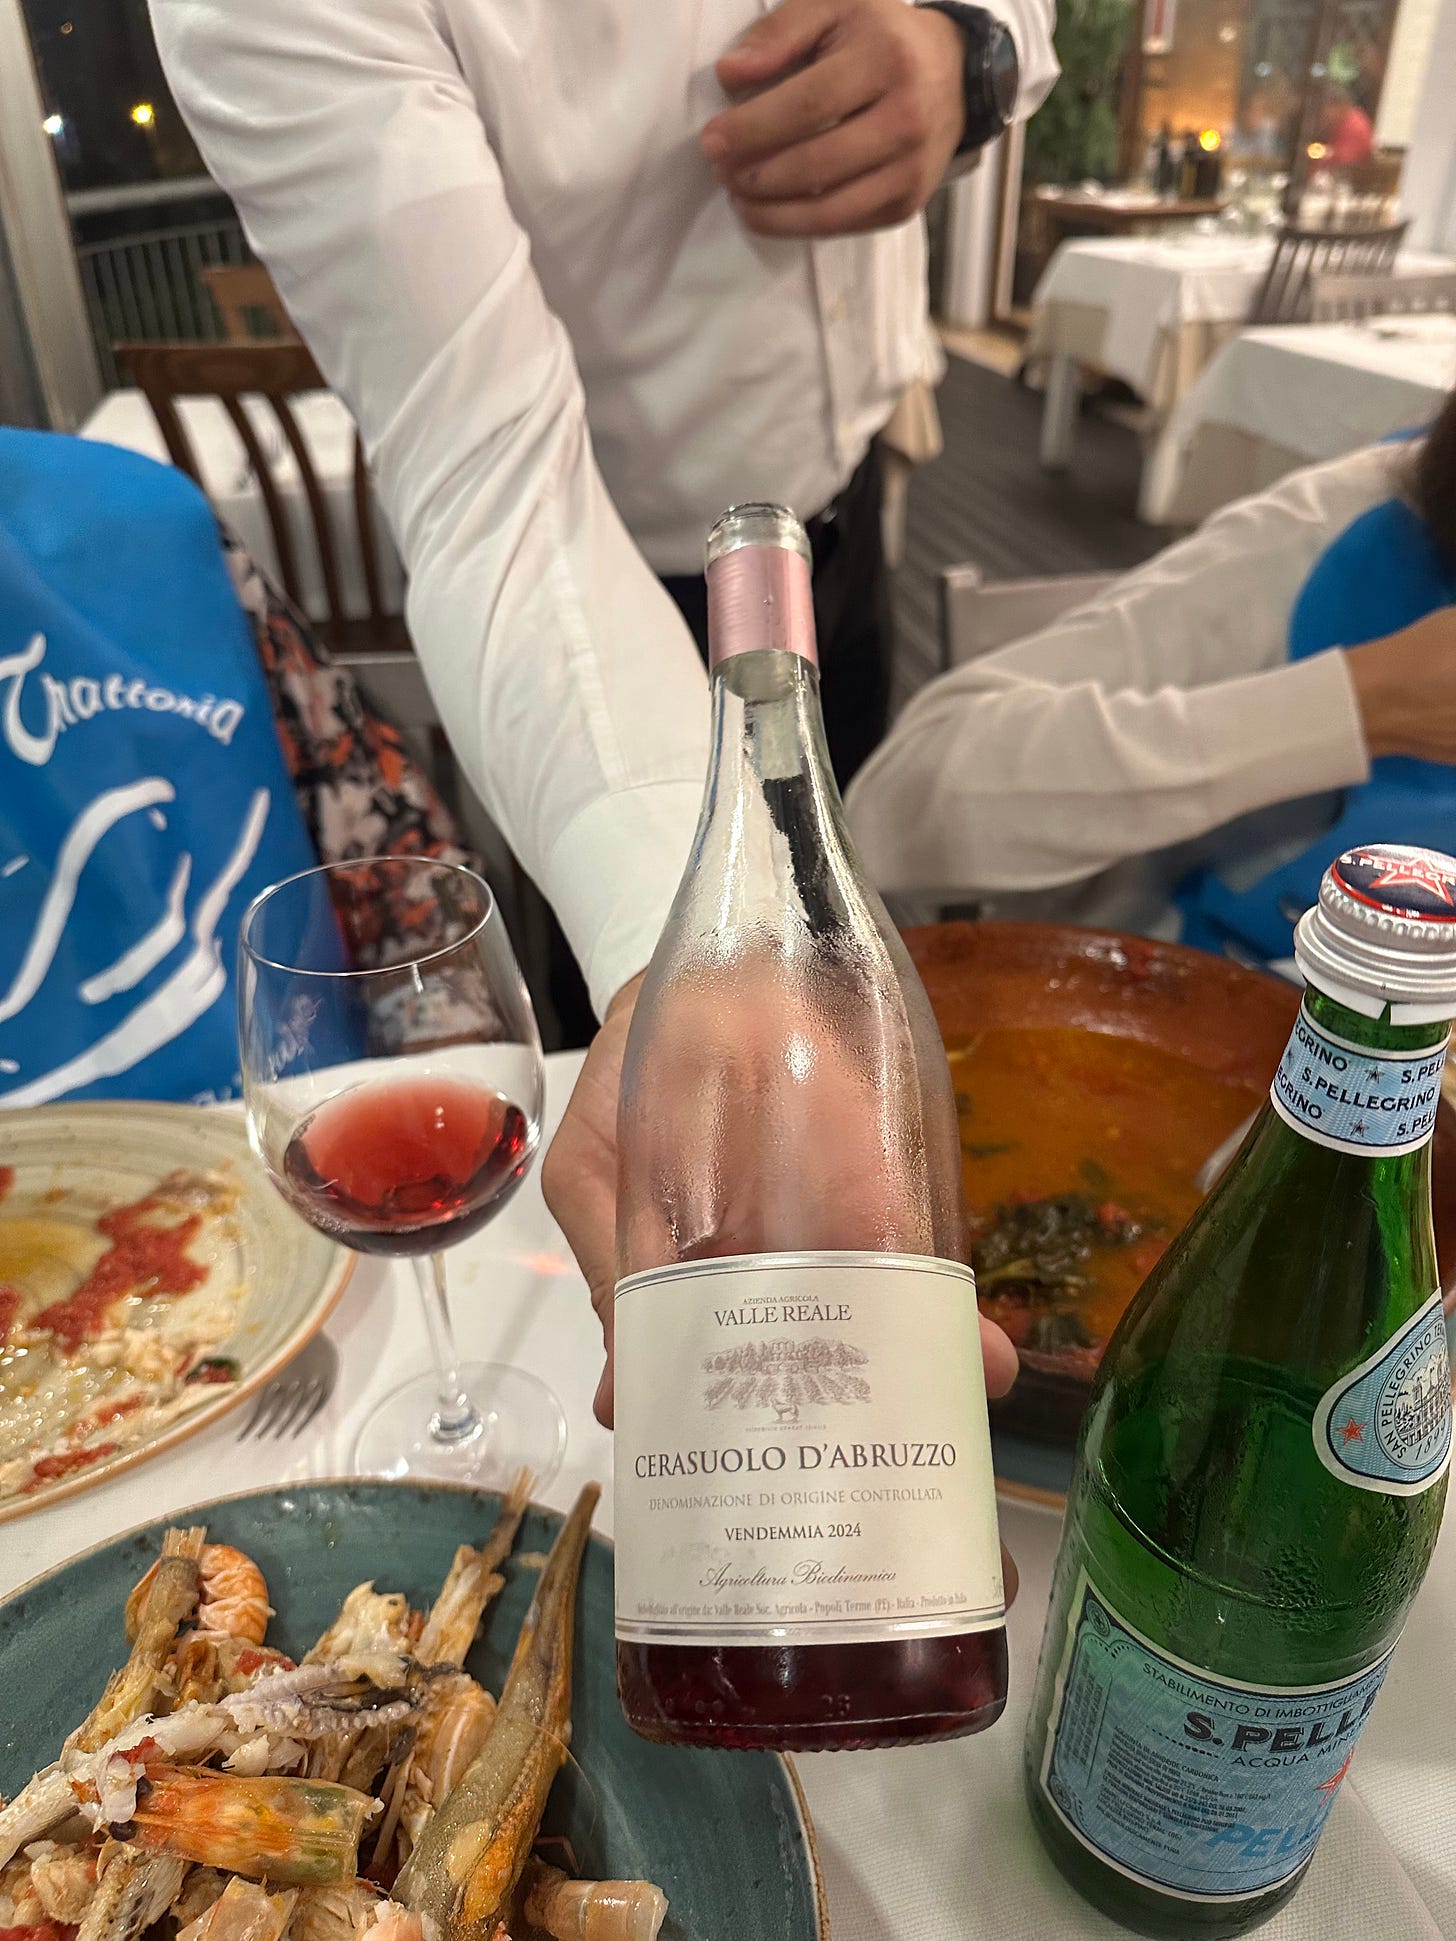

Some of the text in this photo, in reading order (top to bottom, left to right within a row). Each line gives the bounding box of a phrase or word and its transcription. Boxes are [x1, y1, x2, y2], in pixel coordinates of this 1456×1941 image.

[0, 632, 245, 766] Trattoria
[1302, 1066, 1435, 1111] S.PELLEGRINO
[713, 1303, 852, 1327] VALLE REALE
[779, 1295, 819, 1303] AGRICOLA
[1381, 1331, 1431, 1427] PELLEGRINO
[635, 1442, 957, 1479] CERASUOLO D’ABRUZZO
[1384, 1432, 1407, 1459] SAN
[649, 1487, 943, 1511] DENOMINAZIONE DI ORIGINE CONTROLLATA
[724, 1522, 862, 1542] VENDEMMIA 2024
[699, 1559, 897, 1596] Agricoltura Biodinamica
[1143, 1663, 1250, 1715] STABILIMENTO
[1255, 1707, 1270, 1717] DI
[1231, 1753, 1309, 1770] ACQUA
